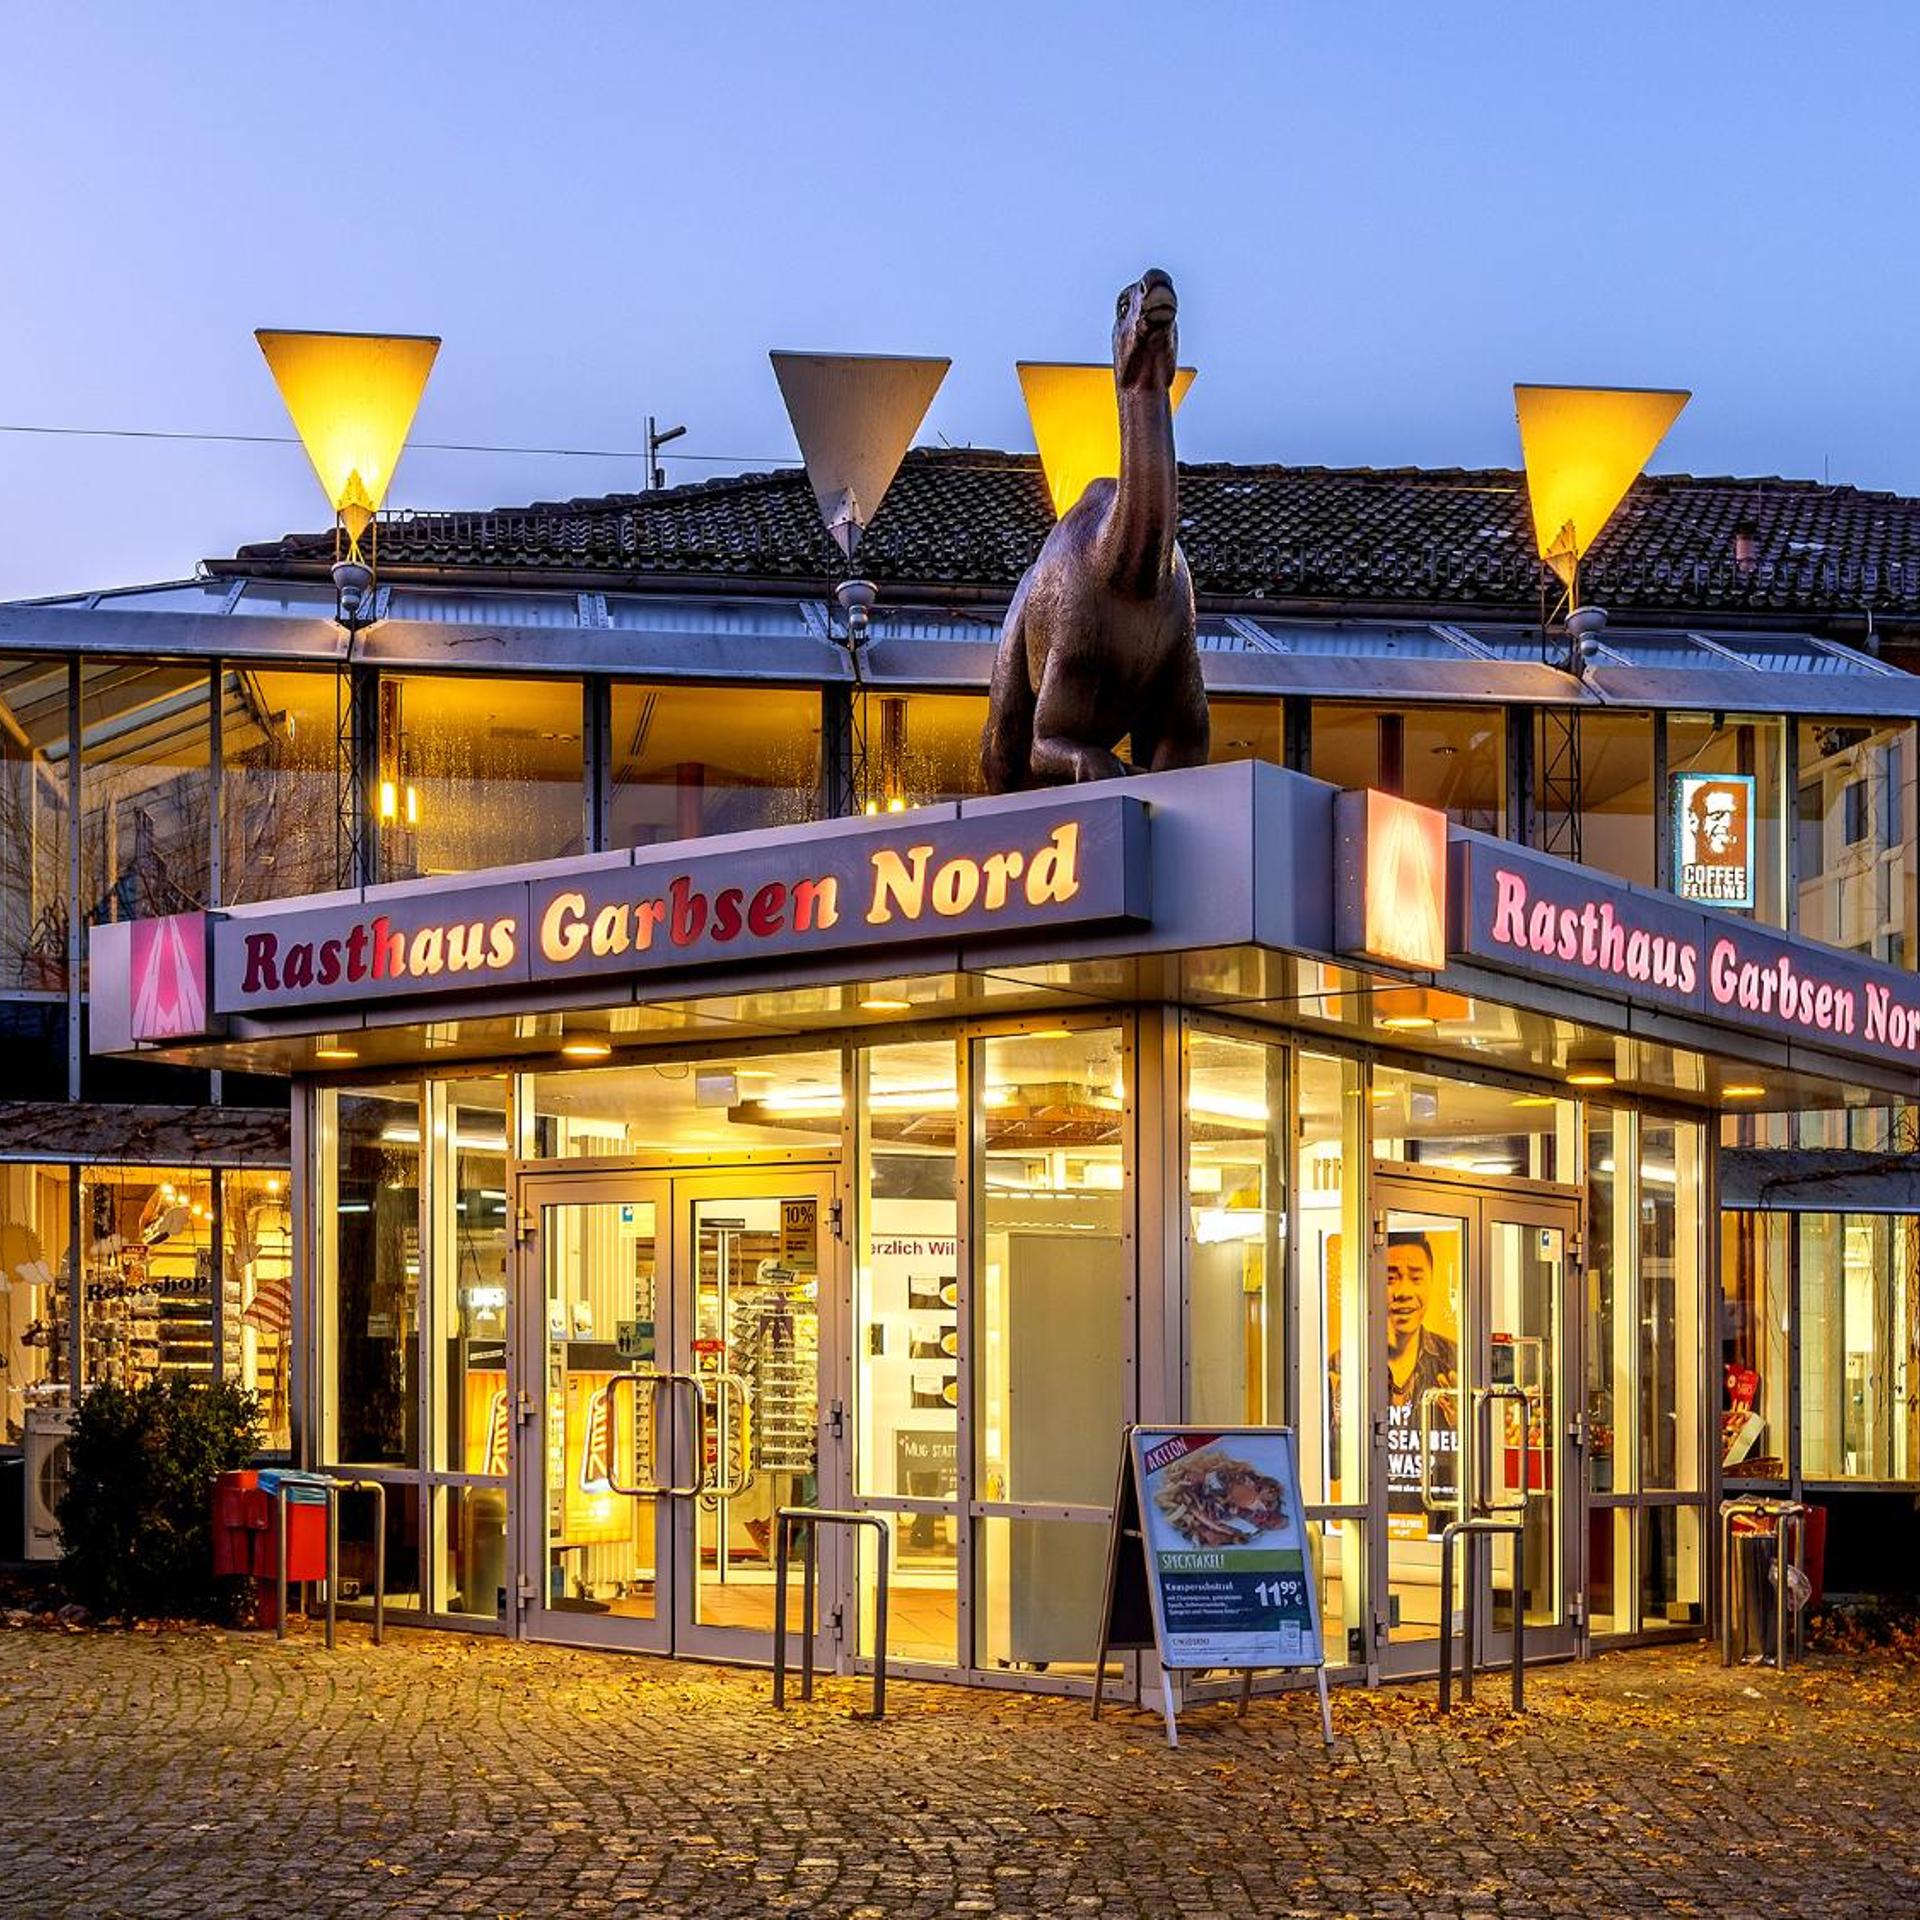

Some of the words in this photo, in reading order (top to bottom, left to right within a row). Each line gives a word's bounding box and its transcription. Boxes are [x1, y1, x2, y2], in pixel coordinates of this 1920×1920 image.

[1684, 865, 1746, 885] COFFEE
[1683, 882, 1747, 899] FELLOWS
[242, 916, 516, 993] Rasthaus
[540, 876, 840, 963] Garbsen
[866, 822, 1080, 925] Nord
[1492, 869, 1697, 994] Rasthaus
[1711, 938, 1855, 1035] Garbsen
[87, 1275, 208, 1301] Reiseshop
[1146, 1437, 1188, 1471] AKTION
